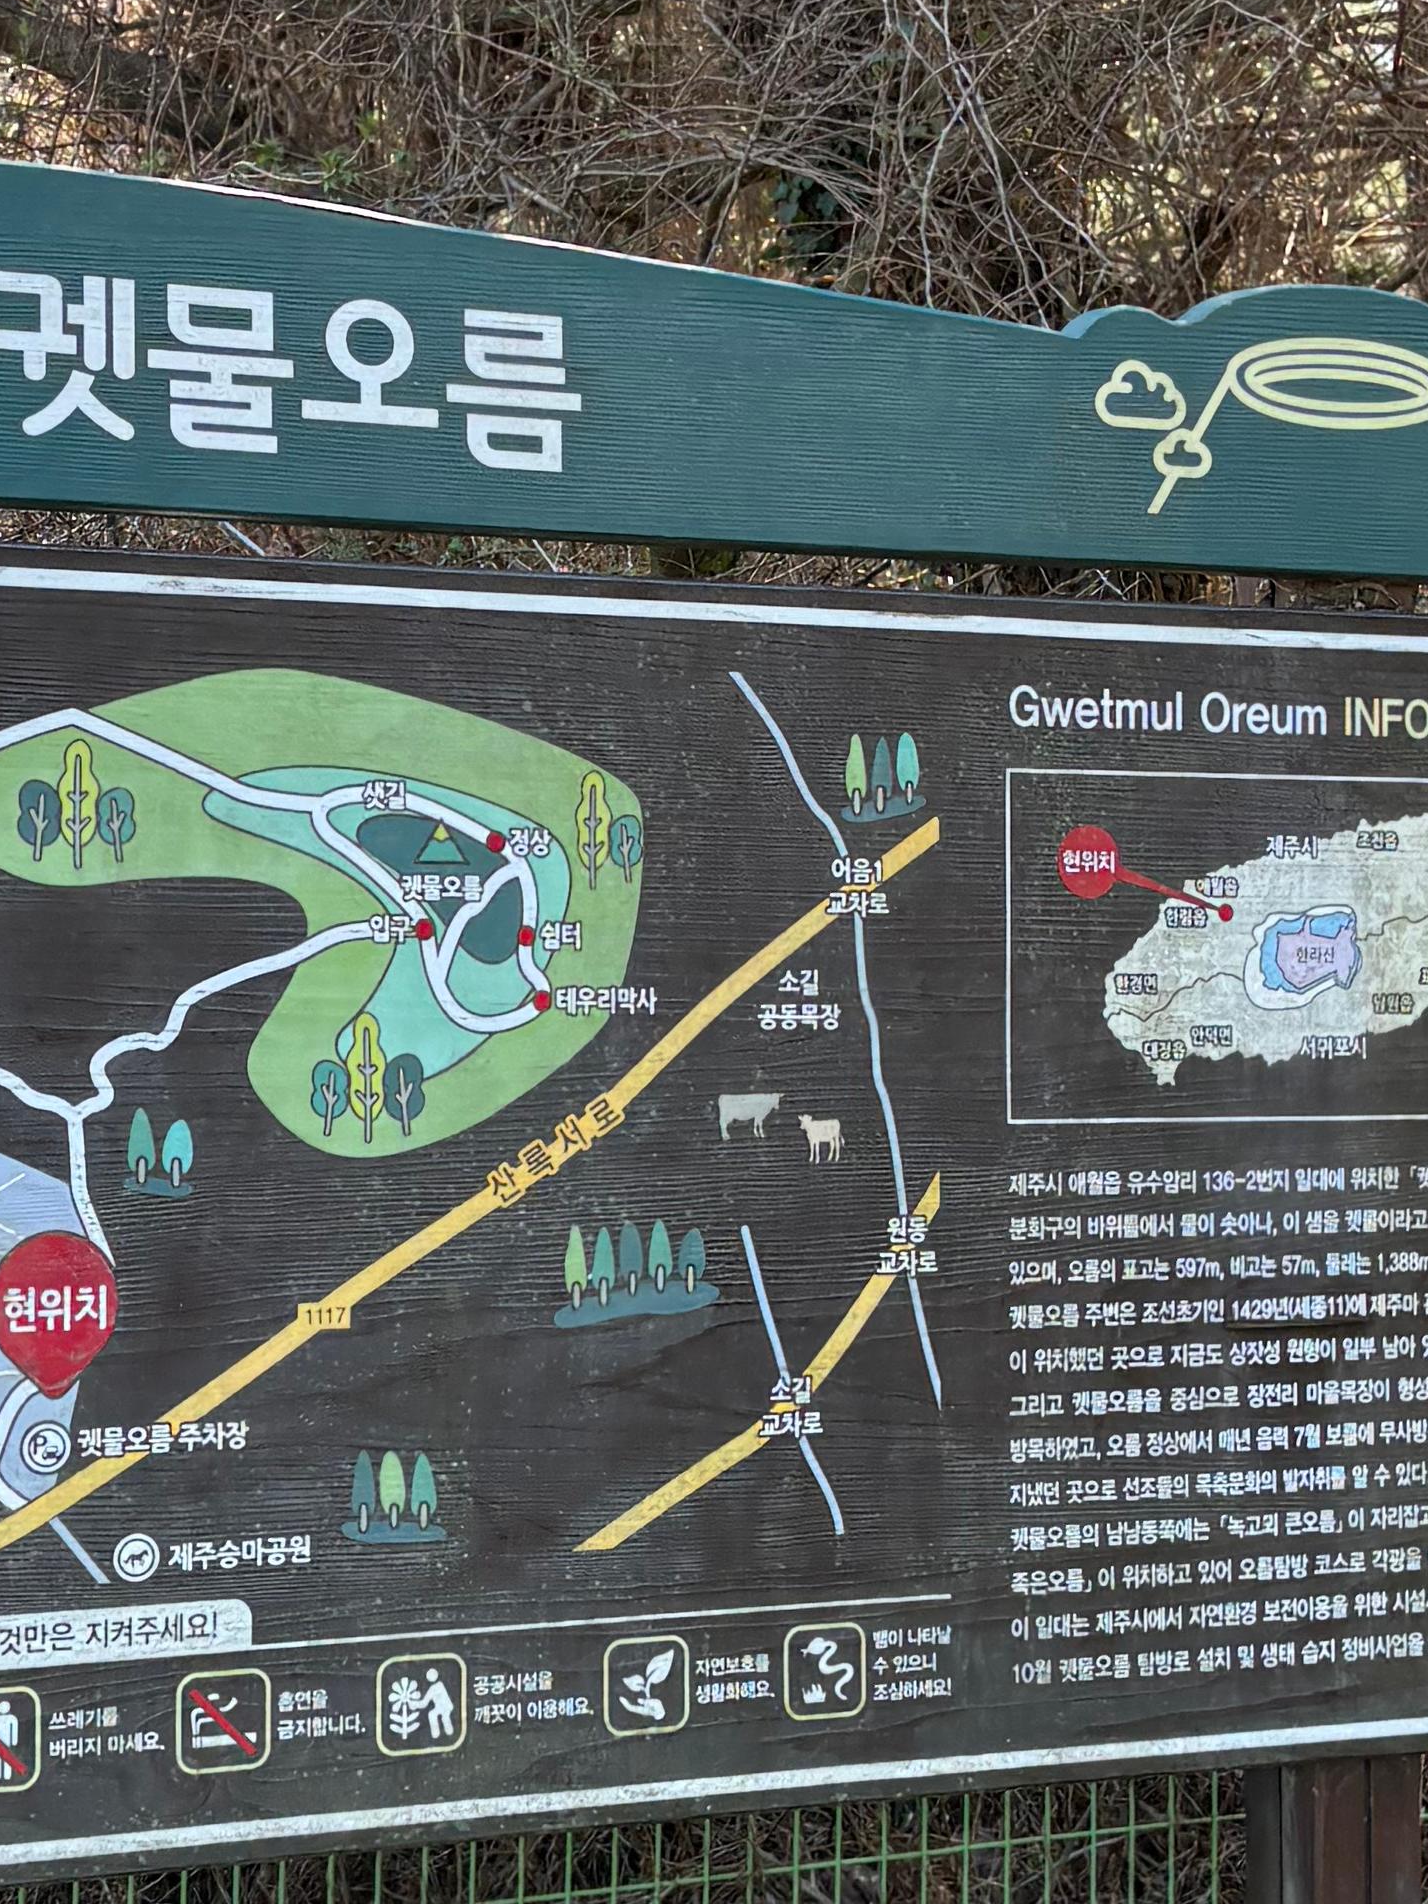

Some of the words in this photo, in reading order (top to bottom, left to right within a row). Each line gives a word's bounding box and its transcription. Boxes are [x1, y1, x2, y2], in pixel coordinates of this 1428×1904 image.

[1008, 684, 1183, 731] Gwetmul
[1200, 692, 1328, 736] Oreum
[362, 781, 406, 810] 샛길
[509, 828, 551, 856] 정상
[1266, 835, 1318, 859] 제주시
[832, 857, 882, 883] 어음1
[1063, 849, 1115, 873] 현위치
[401, 875, 483, 900] 궷물오름
[827, 892, 890, 918] 교차로
[370, 915, 411, 943] 입구
[540, 921, 582, 950] 쉼터
[1297, 947, 1335, 964] 한라산
[778, 969, 819, 996] 소길
[556, 987, 657, 1015] 테우리막사
[757, 1003, 841, 1031] 공동목장
[1300, 1035, 1367, 1060] 서귀포시
[491, 1097, 621, 1202] 산록서로
[1008, 1171, 1063, 1197] 제주시
[1126, 1169, 1197, 1195] 유수암리
[1202, 1168, 1290, 1193] 136-2번지
[1294, 1167, 1345, 1192] 일대에
[1350, 1166, 1400, 1191] 위치한
[886, 1217, 929, 1244] 원동
[1008, 1215, 1082, 1241] 분화구의
[1219, 1210, 1278, 1237] 솟아나,
[1282, 1210, 1300, 1235] 이
[877, 1250, 938, 1276] 교차로
[1008, 1259, 1062, 1286] 있으며,
[1067, 1257, 1116, 1283] 오름의
[1175, 1257, 1225, 1281] 597m,
[1230, 1254, 1277, 1279] 비고는
[1281, 1254, 1321, 1278] 57m,
[2, 1284, 108, 1334] 현위치
[305, 1306, 346, 1326] 1117
[1009, 1348, 1027, 1375] 이
[1110, 1345, 1166, 1371] 곳으로
[1169, 1342, 1224, 1368] 지금도
[1342, 1336, 1377, 1361] 일부
[1382, 1334, 1417, 1360] 남아
[770, 1376, 811, 1403] 소길
[1009, 1392, 1065, 1418] 그리고
[1169, 1385, 1241, 1412] 중심으로
[1246, 1381, 1298, 1409] 장전리
[760, 1410, 823, 1437] 교차로
[77, 1424, 174, 1457] 궷물오름
[178, 1421, 250, 1451] 주차장
[1106, 1432, 1142, 1458] 오름
[1146, 1428, 1213, 1457] 정상에서
[1065, 1478, 1118, 1504] 곳으로
[1373, 1463, 1391, 1488] 수
[168, 1535, 311, 1571] 제주승마공원
[1121, 1562, 1193, 1589] 위치하고
[1197, 1558, 1232, 1585] 있어
[1313, 1551, 1367, 1575] 코스로
[1011, 1615, 1029, 1641] 이
[1035, 1613, 1090, 1640] 일대는
[1095, 1605, 1183, 1635] 제주시에서
[1353, 1590, 1389, 1617] 위한
[86, 1611, 219, 1650] 지켜주세요!
[873, 1658, 889, 1676] 수
[894, 1652, 937, 1672] 있으니
[1196, 1645, 1231, 1672] 설치
[1260, 1641, 1296, 1668] 생태
[873, 1677, 952, 1701] 조심하세요!
[49, 1736, 101, 1759] 버리지
[108, 1731, 165, 1754] 마세요.
